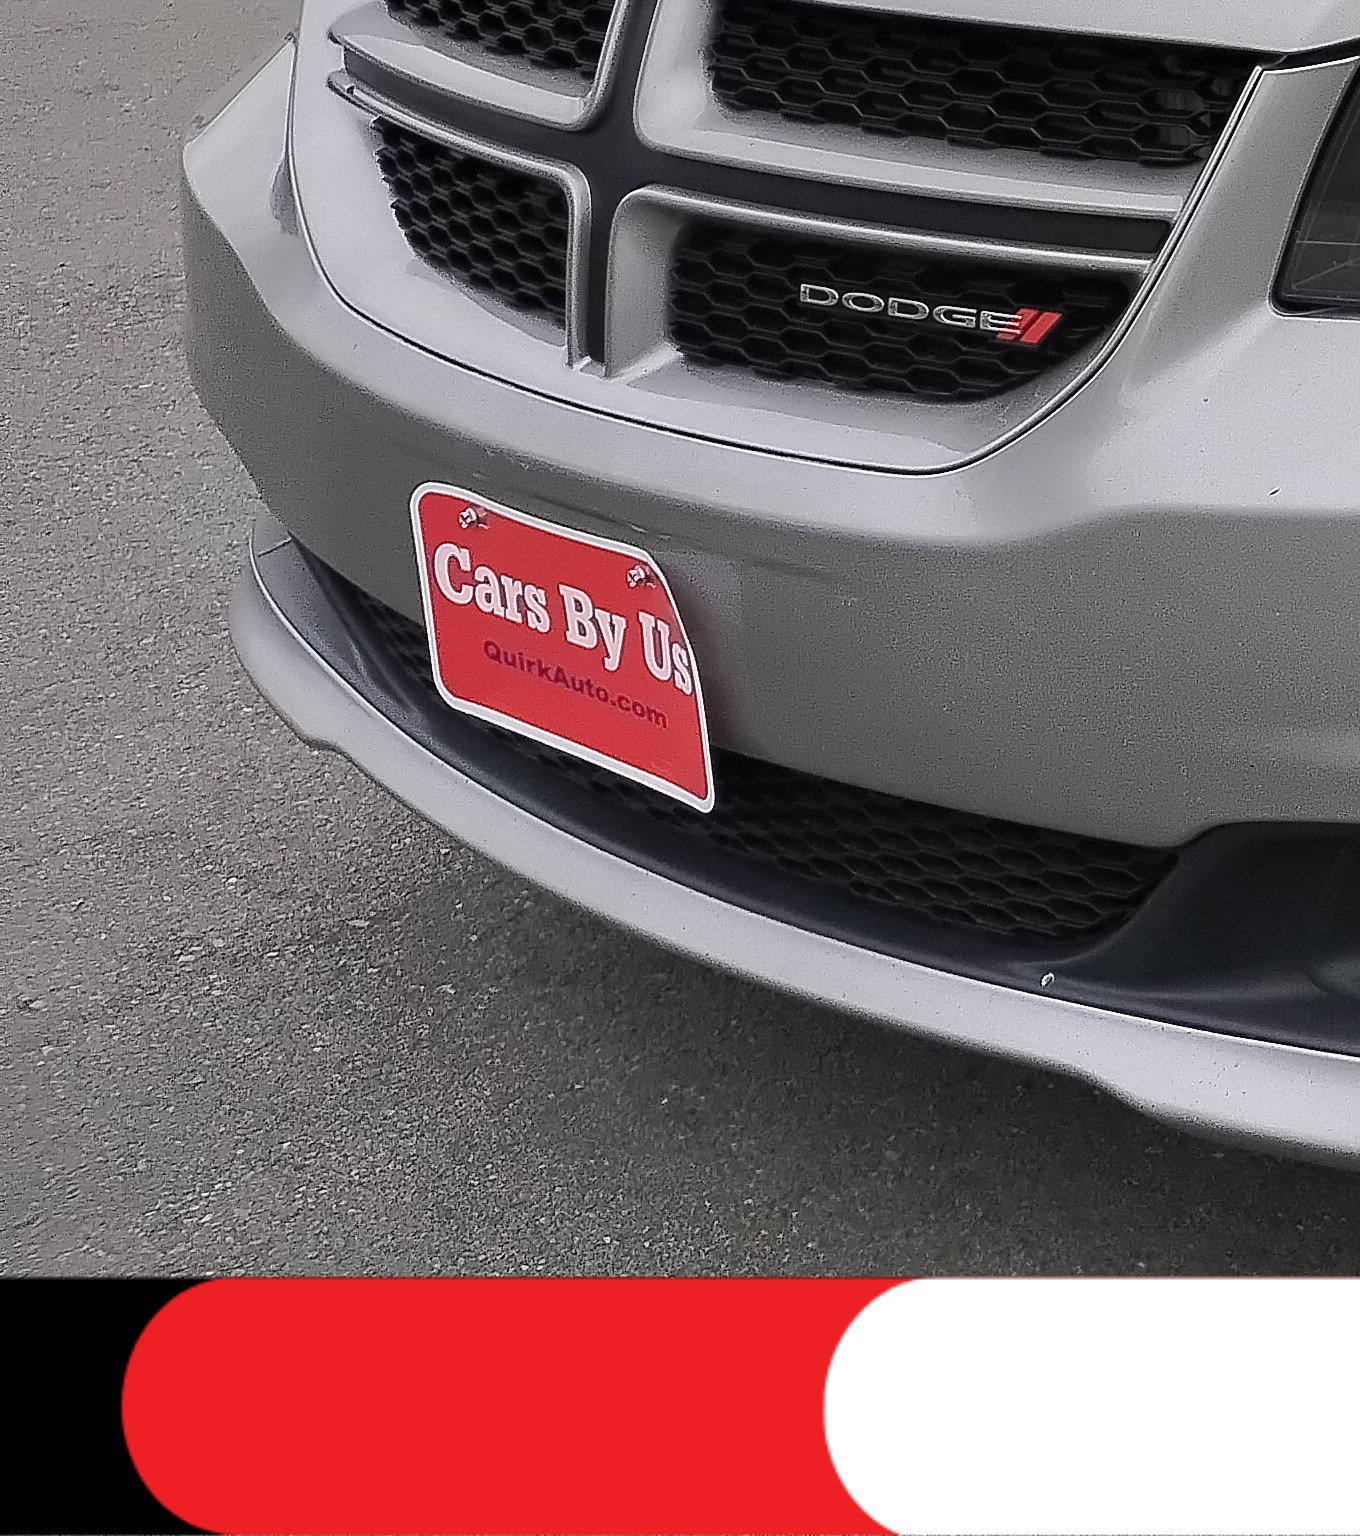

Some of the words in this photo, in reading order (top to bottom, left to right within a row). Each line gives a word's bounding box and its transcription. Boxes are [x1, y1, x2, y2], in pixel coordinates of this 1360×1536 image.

[800, 283, 1023, 335] DODGE
[434, 543, 551, 633] Cars
[559, 584, 627, 672] By
[639, 611, 693, 696] Us
[483, 640, 668, 730] QuirkAuto.com
